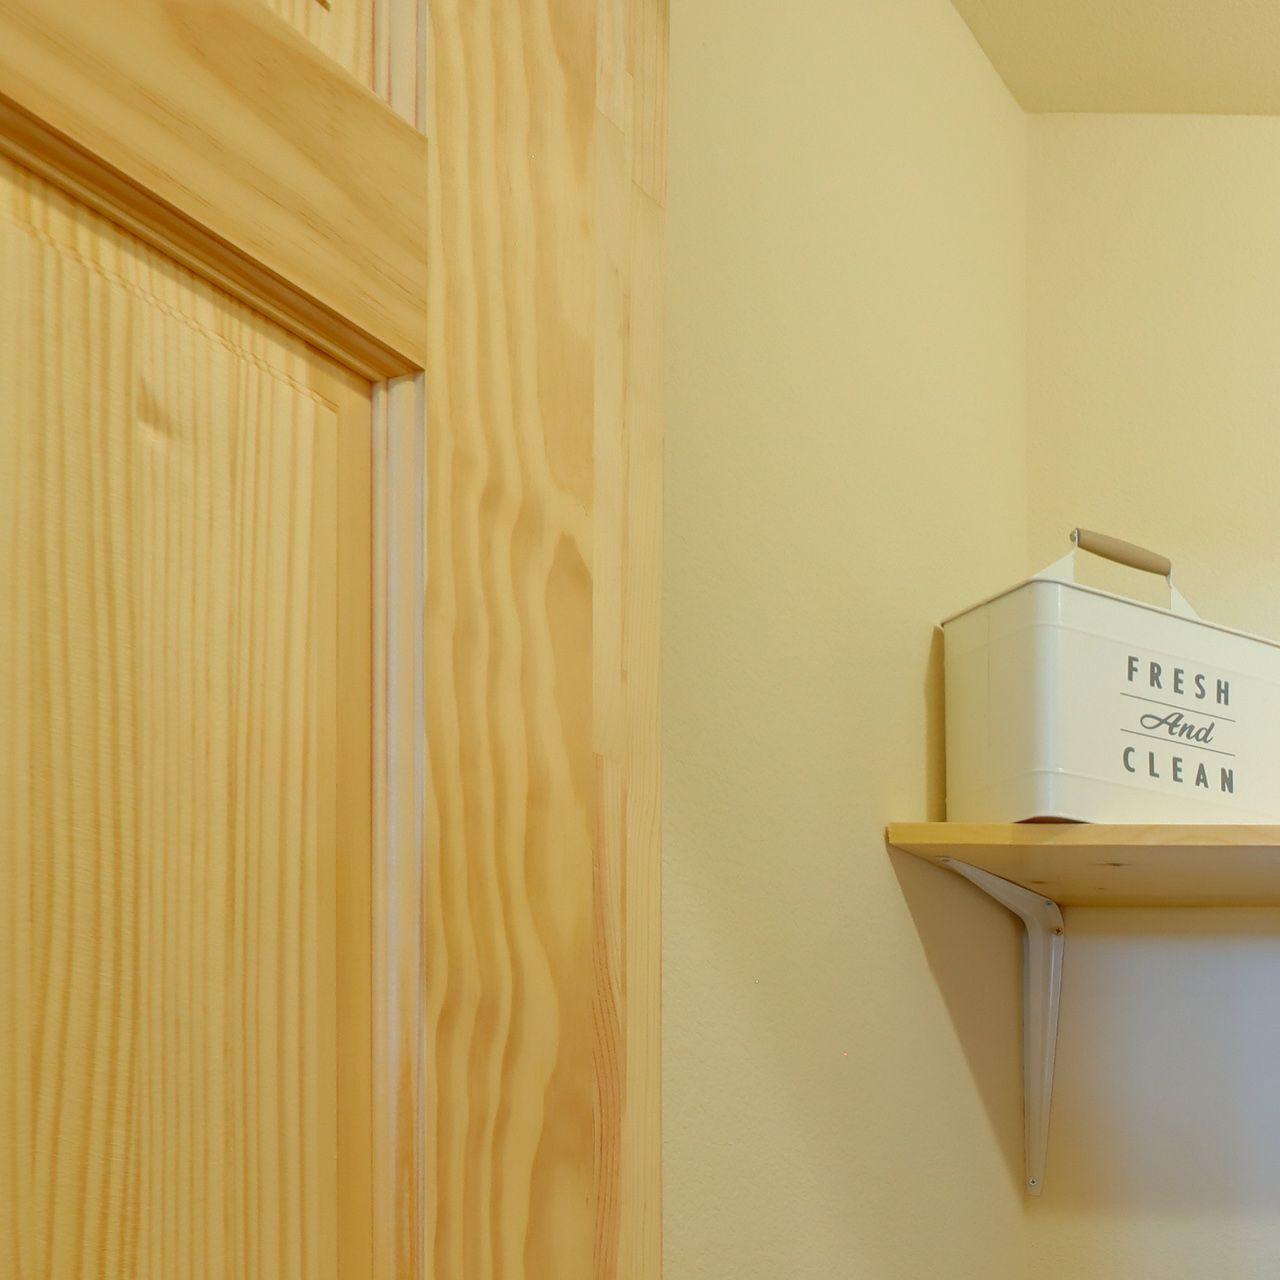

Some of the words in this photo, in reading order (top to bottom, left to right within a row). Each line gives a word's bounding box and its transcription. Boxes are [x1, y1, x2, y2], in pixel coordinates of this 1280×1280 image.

[1128, 655, 1230, 706] FRESH
[1140, 711, 1215, 744] And
[1123, 746, 1234, 794] CLEAN
